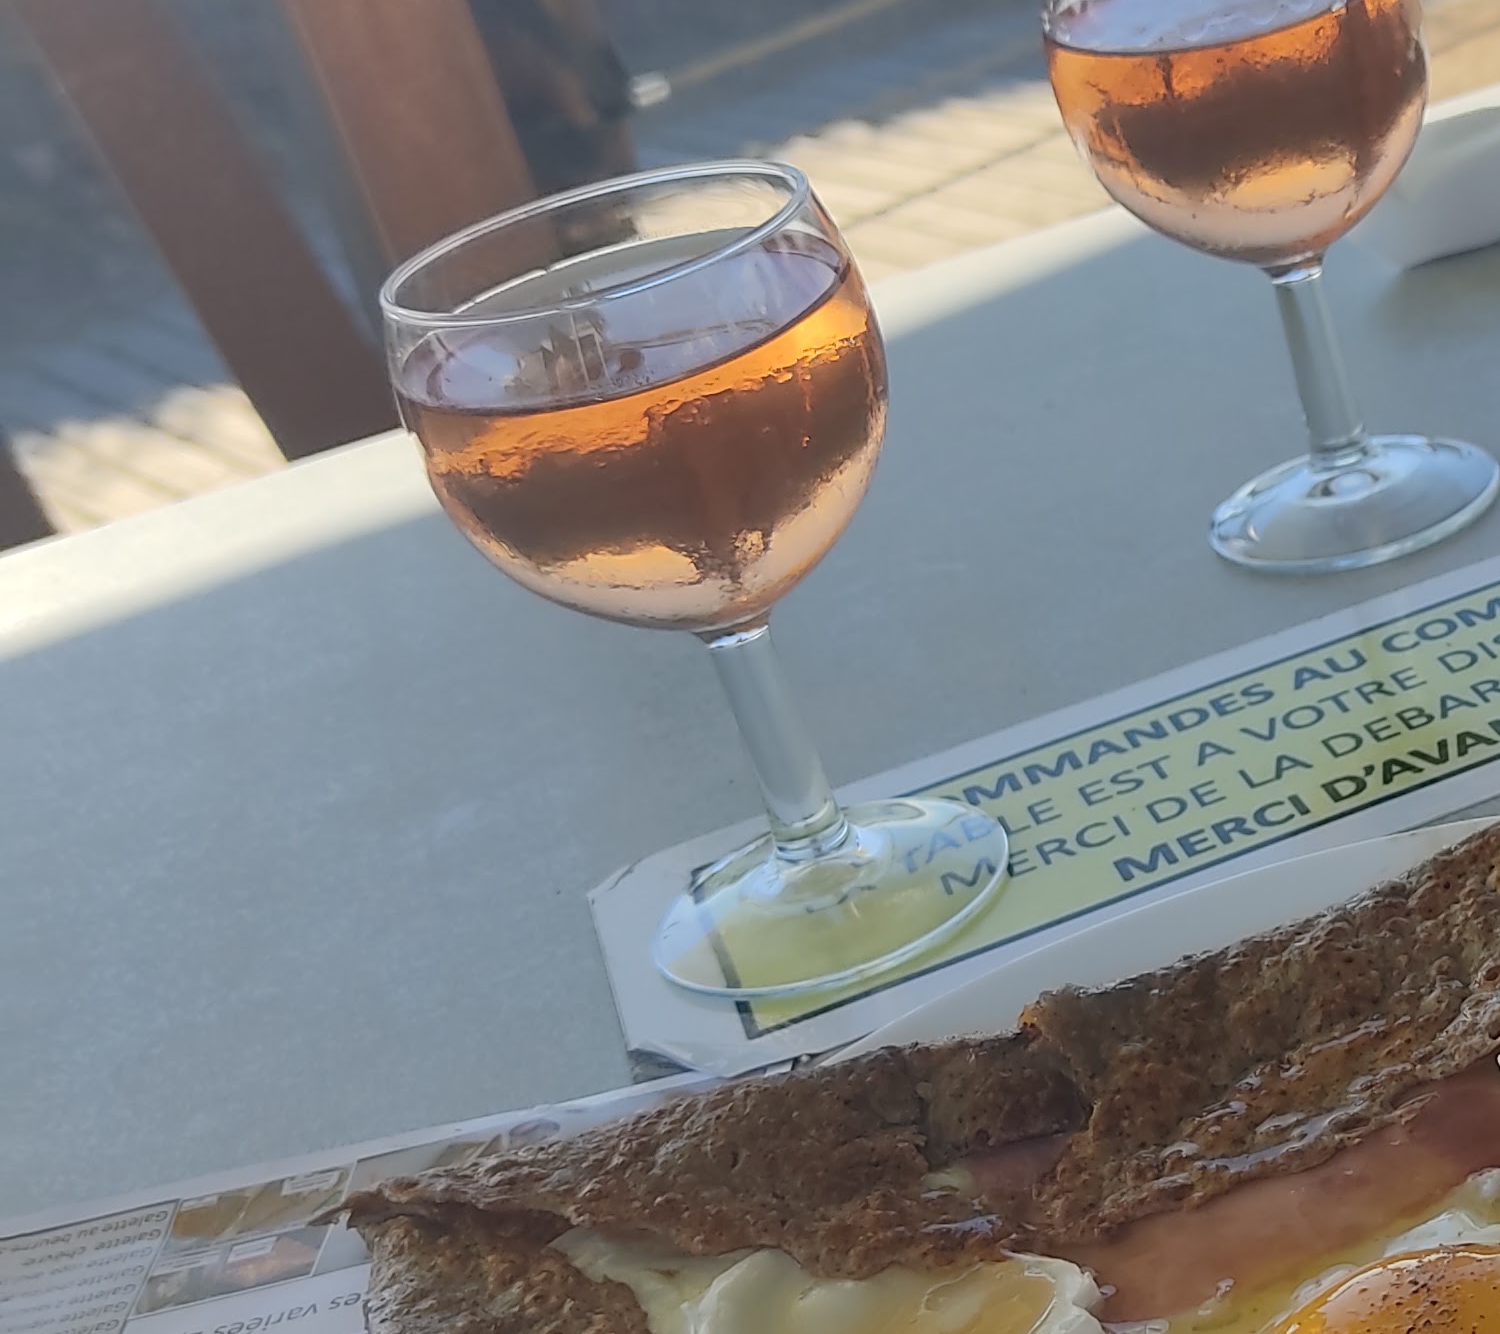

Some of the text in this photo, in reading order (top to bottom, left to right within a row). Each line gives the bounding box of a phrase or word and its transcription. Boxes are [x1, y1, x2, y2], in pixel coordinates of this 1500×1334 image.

[946, 681, 1275, 807] MMANDES
[1293, 647, 1368, 691] AU
[1077, 754, 1171, 807] EST
[1196, 741, 1236, 766] A
[1240, 666, 1428, 742] VOTRE
[940, 814, 1132, 897] MERCI
[1145, 779, 1227, 825] DE
[1238, 753, 1314, 789] LA
[1112, 794, 1313, 882] MERCI
